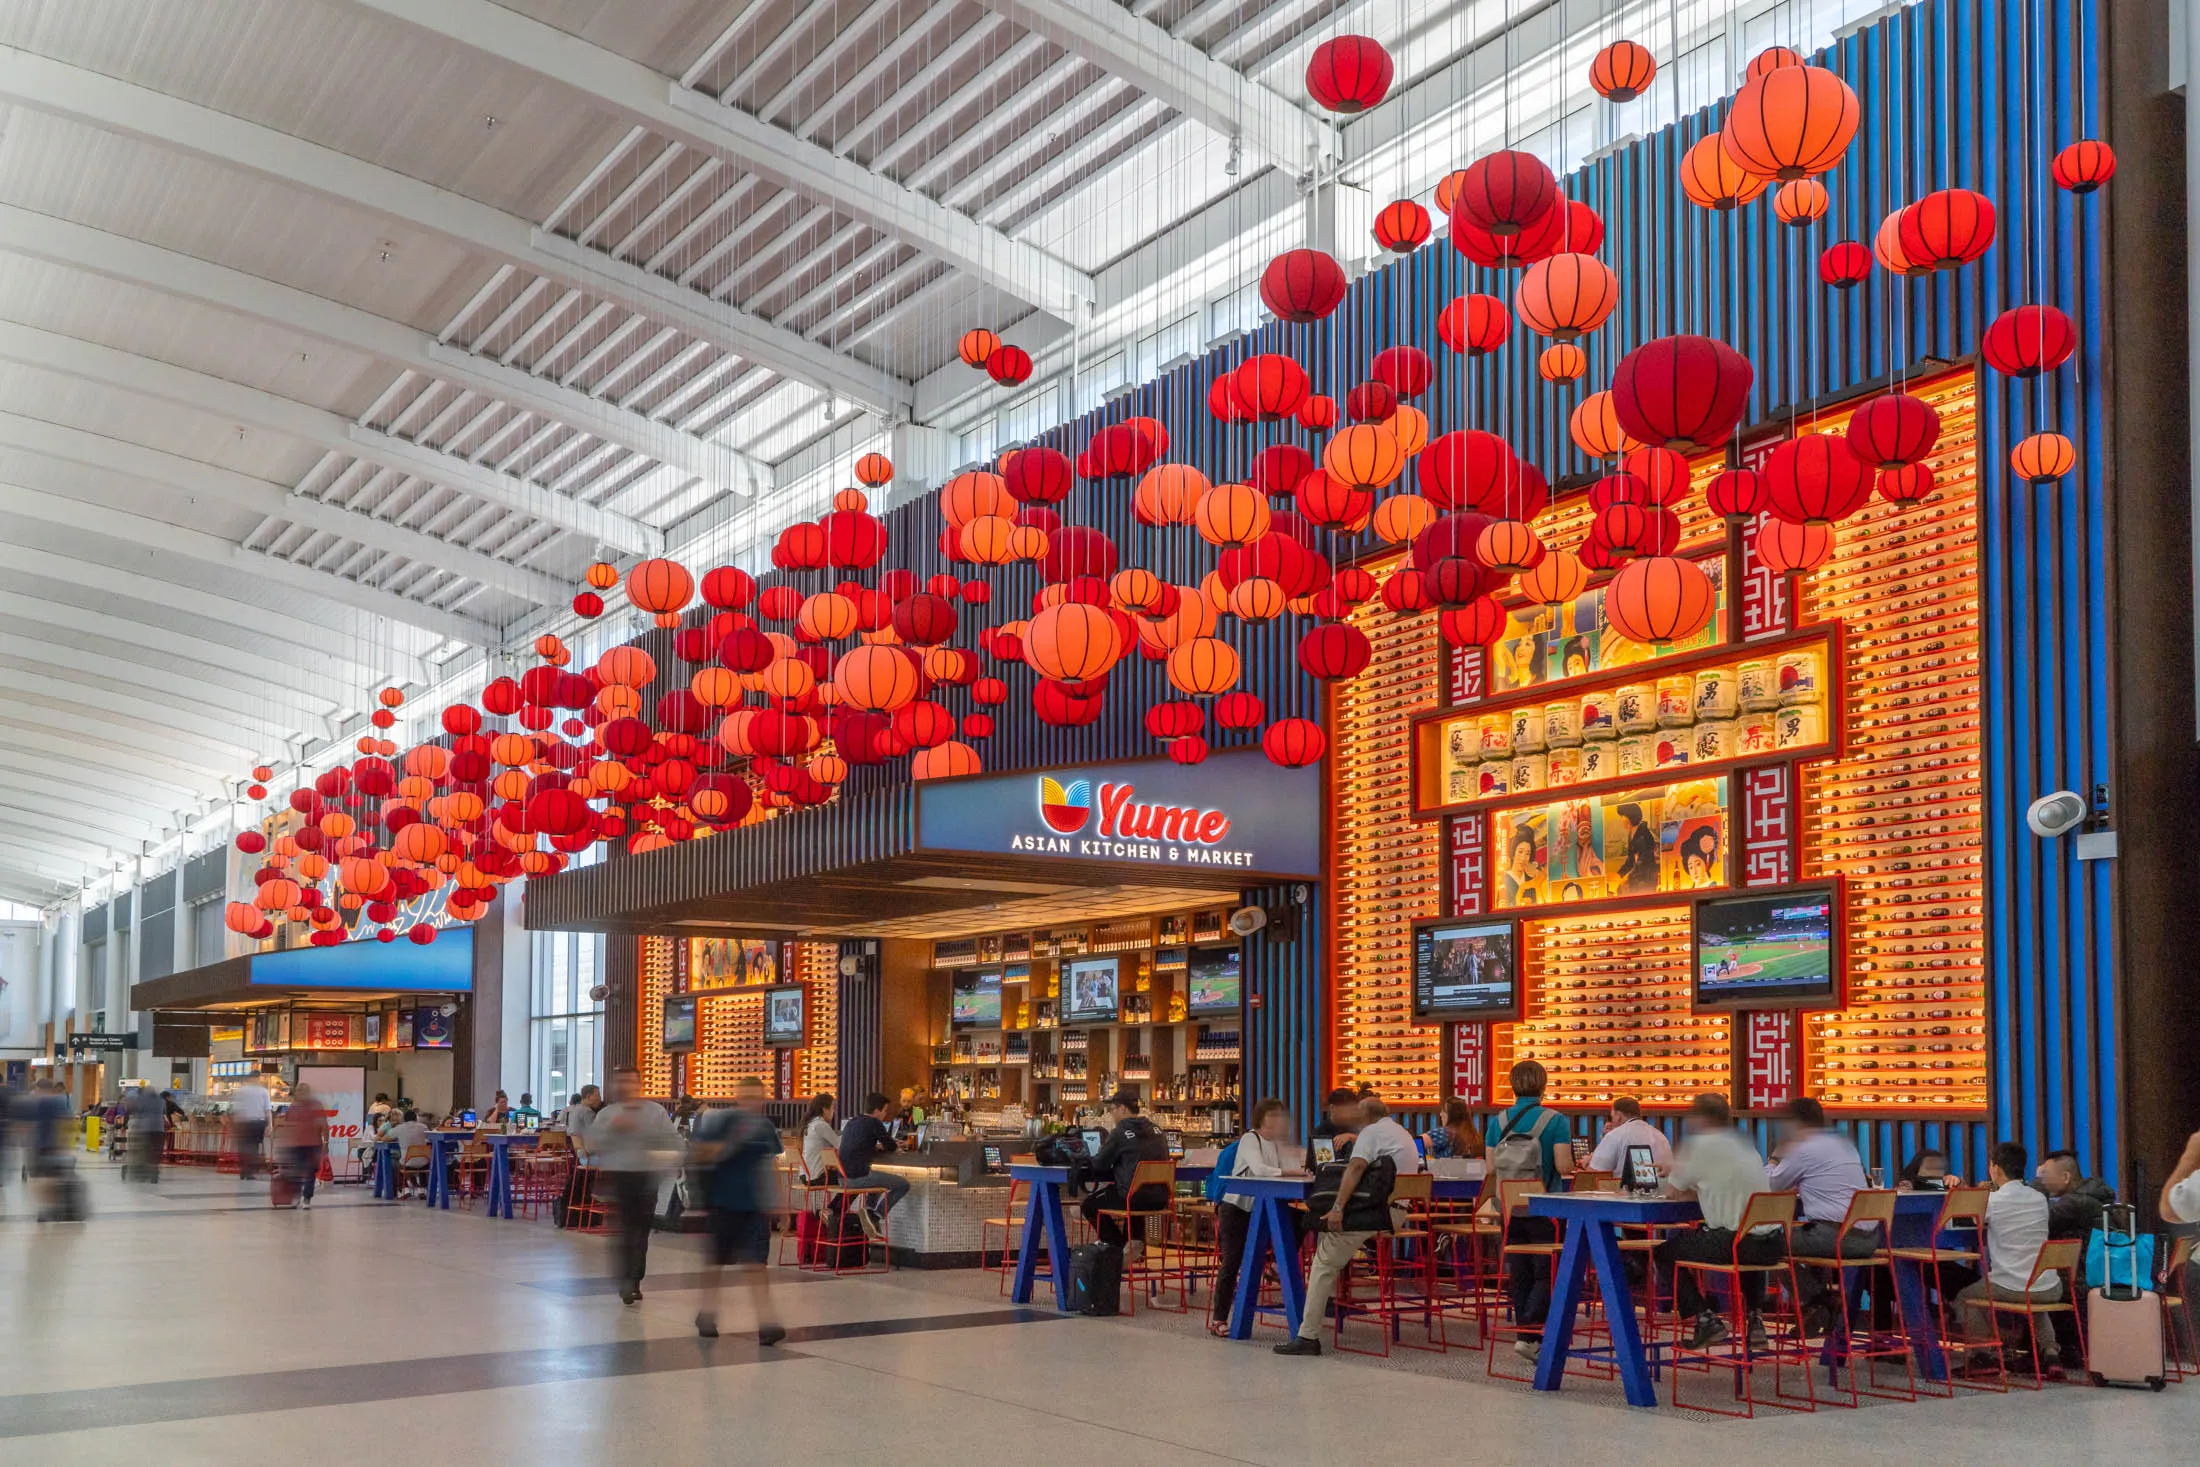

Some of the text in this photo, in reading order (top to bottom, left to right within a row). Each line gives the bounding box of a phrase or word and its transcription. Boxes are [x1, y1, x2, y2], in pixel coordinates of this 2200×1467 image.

[1099, 783, 1231, 844] Yume
[1011, 834, 1254, 866] ASIAN KITCHEN & MARKET
[1124, 1129, 1136, 1139] S
